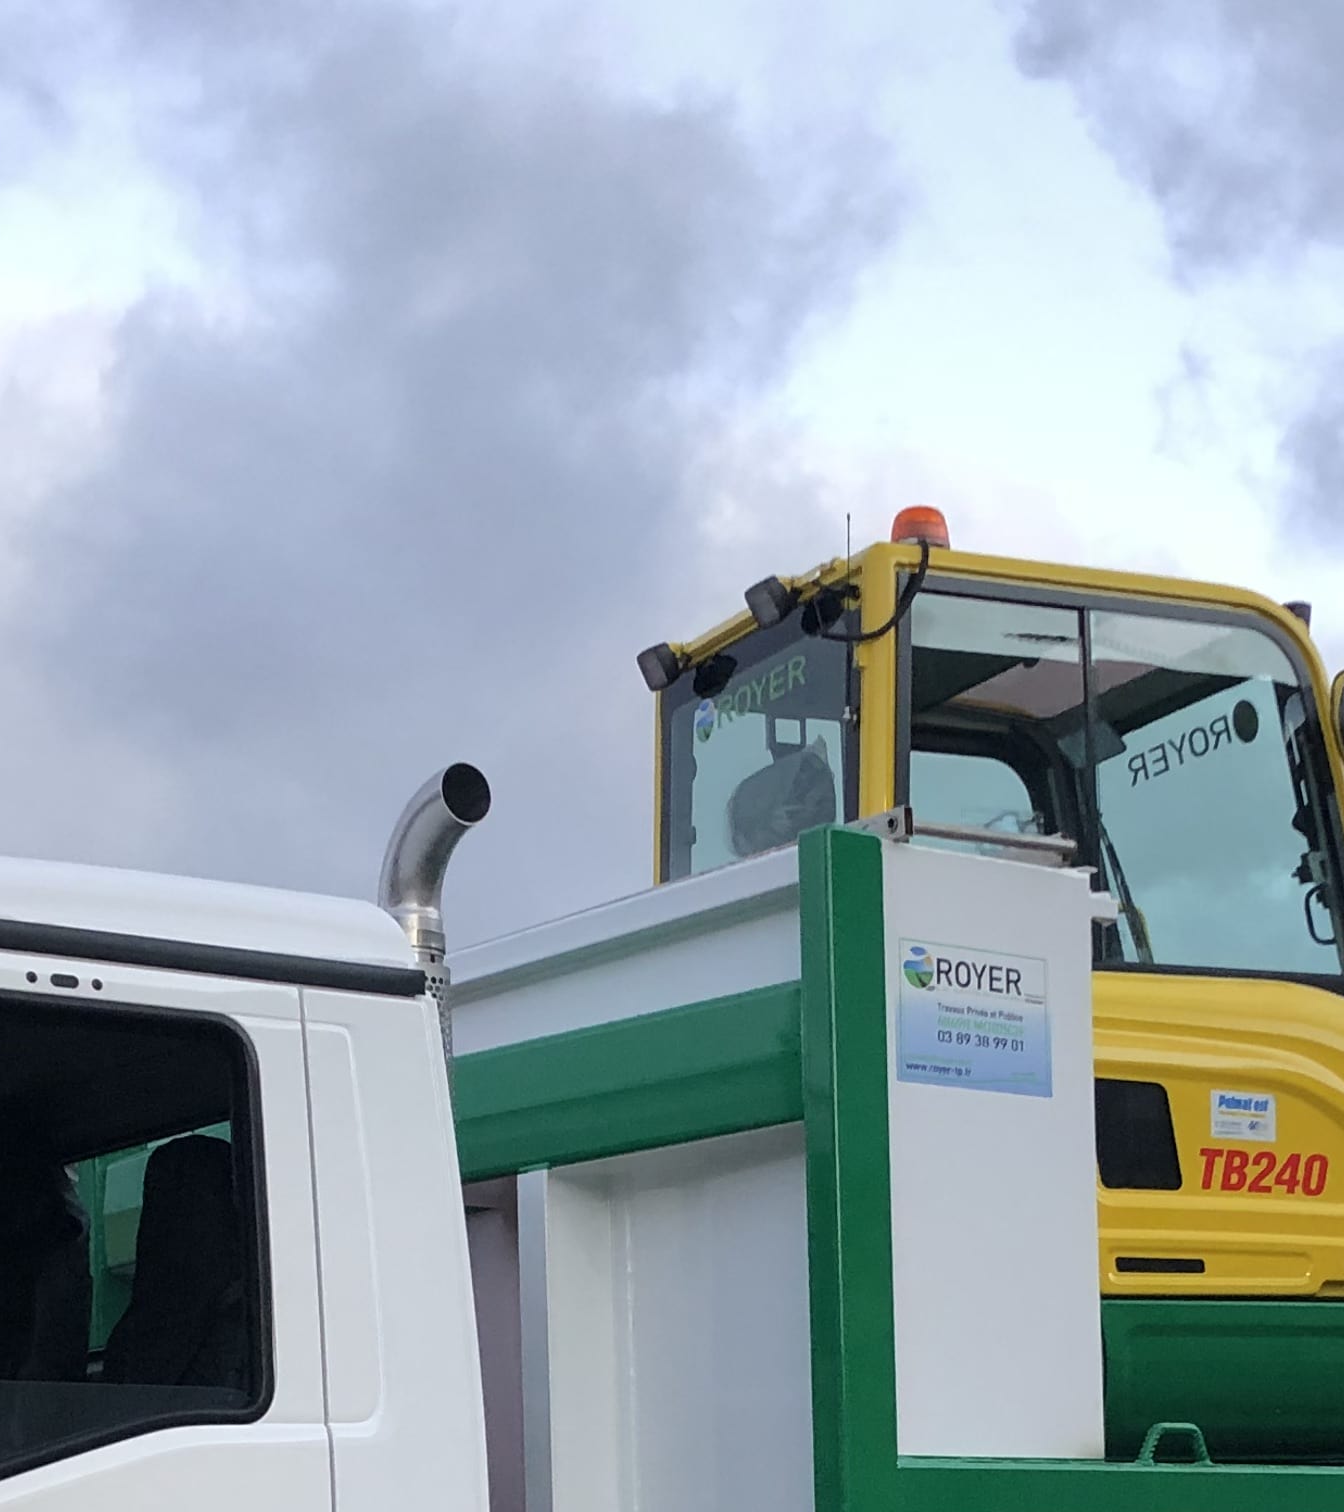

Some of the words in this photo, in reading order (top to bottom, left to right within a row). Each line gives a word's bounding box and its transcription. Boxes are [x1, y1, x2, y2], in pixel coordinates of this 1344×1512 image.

[717, 655, 806, 729] ROYER
[935, 957, 1023, 997] ROYER
[937, 1030, 952, 1044] 03
[956, 1032, 971, 1046] 89
[974, 1033, 990, 1048] 38
[992, 1036, 1008, 1050] 99
[1199, 1148, 1329, 1196] TB240
